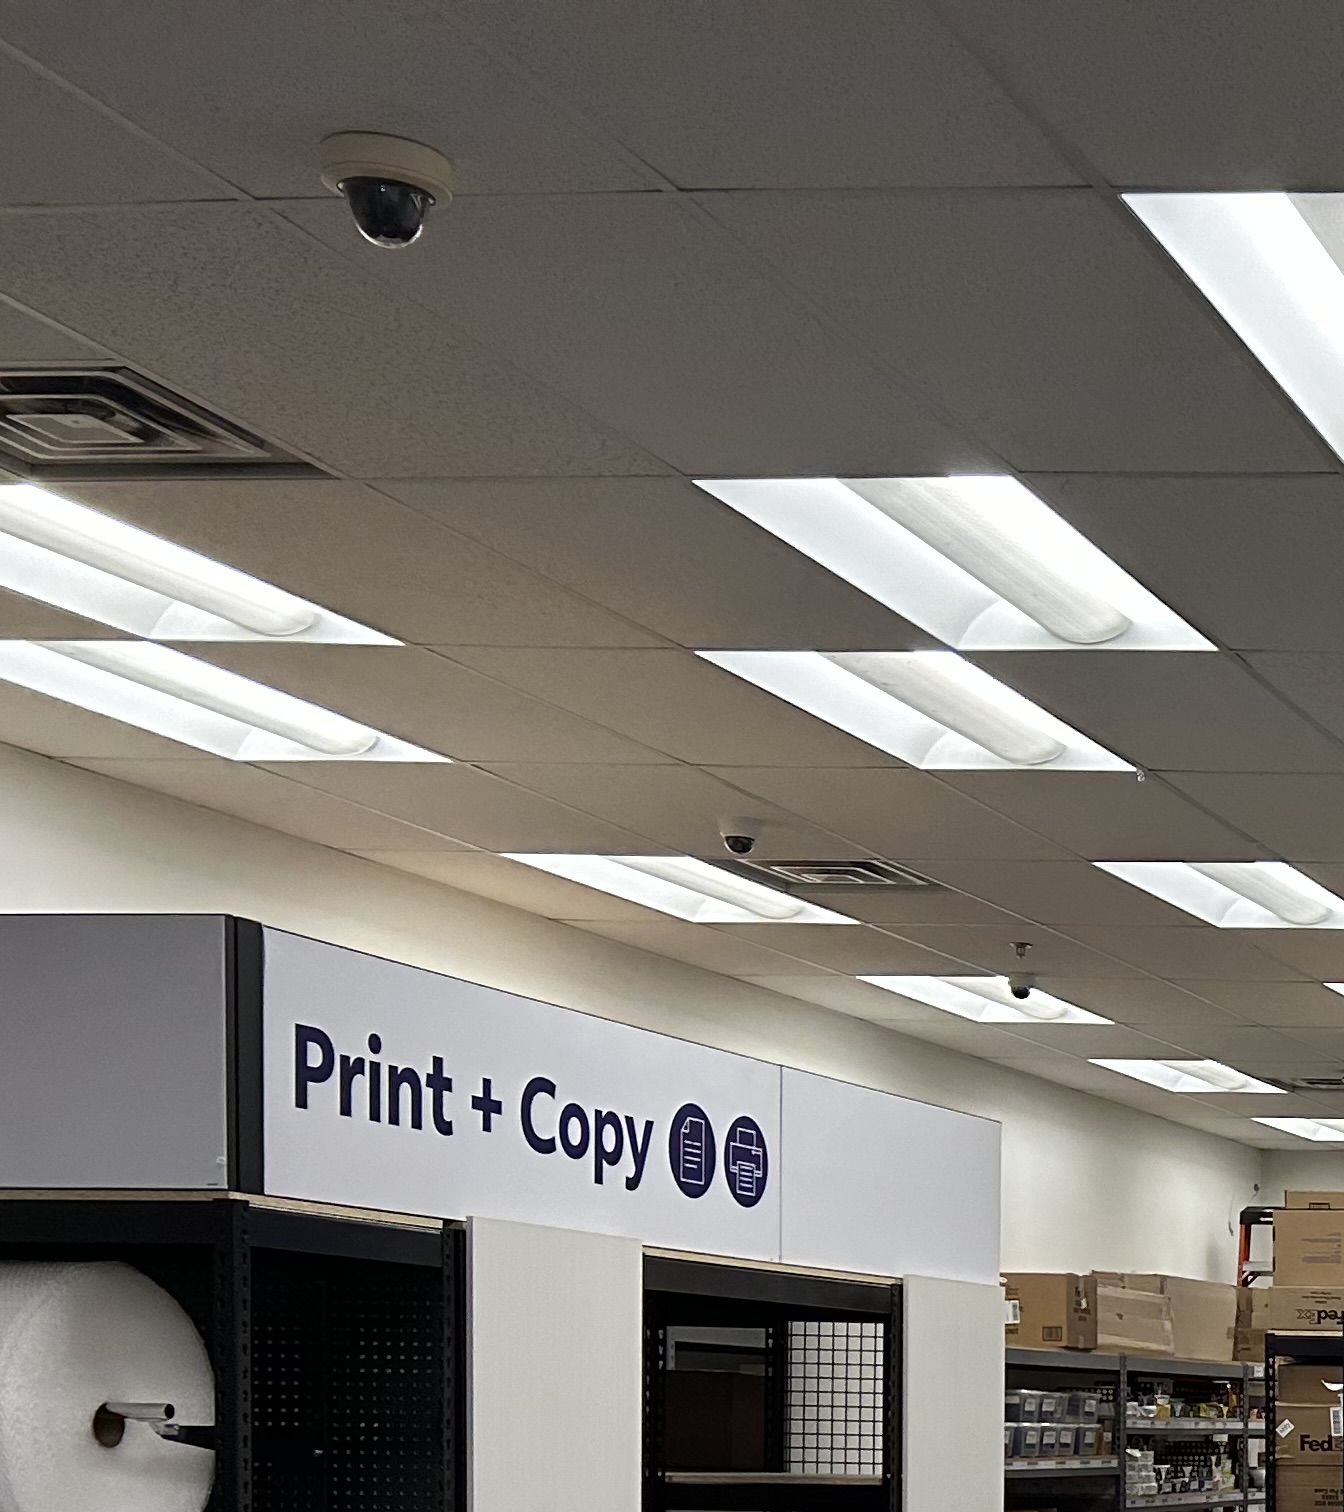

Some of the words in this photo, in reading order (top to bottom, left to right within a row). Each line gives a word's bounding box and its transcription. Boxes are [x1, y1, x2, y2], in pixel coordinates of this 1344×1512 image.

[295, 1022, 453, 1136] Print
[471, 1077, 502, 1133] +
[520, 1076, 654, 1192] Copy
